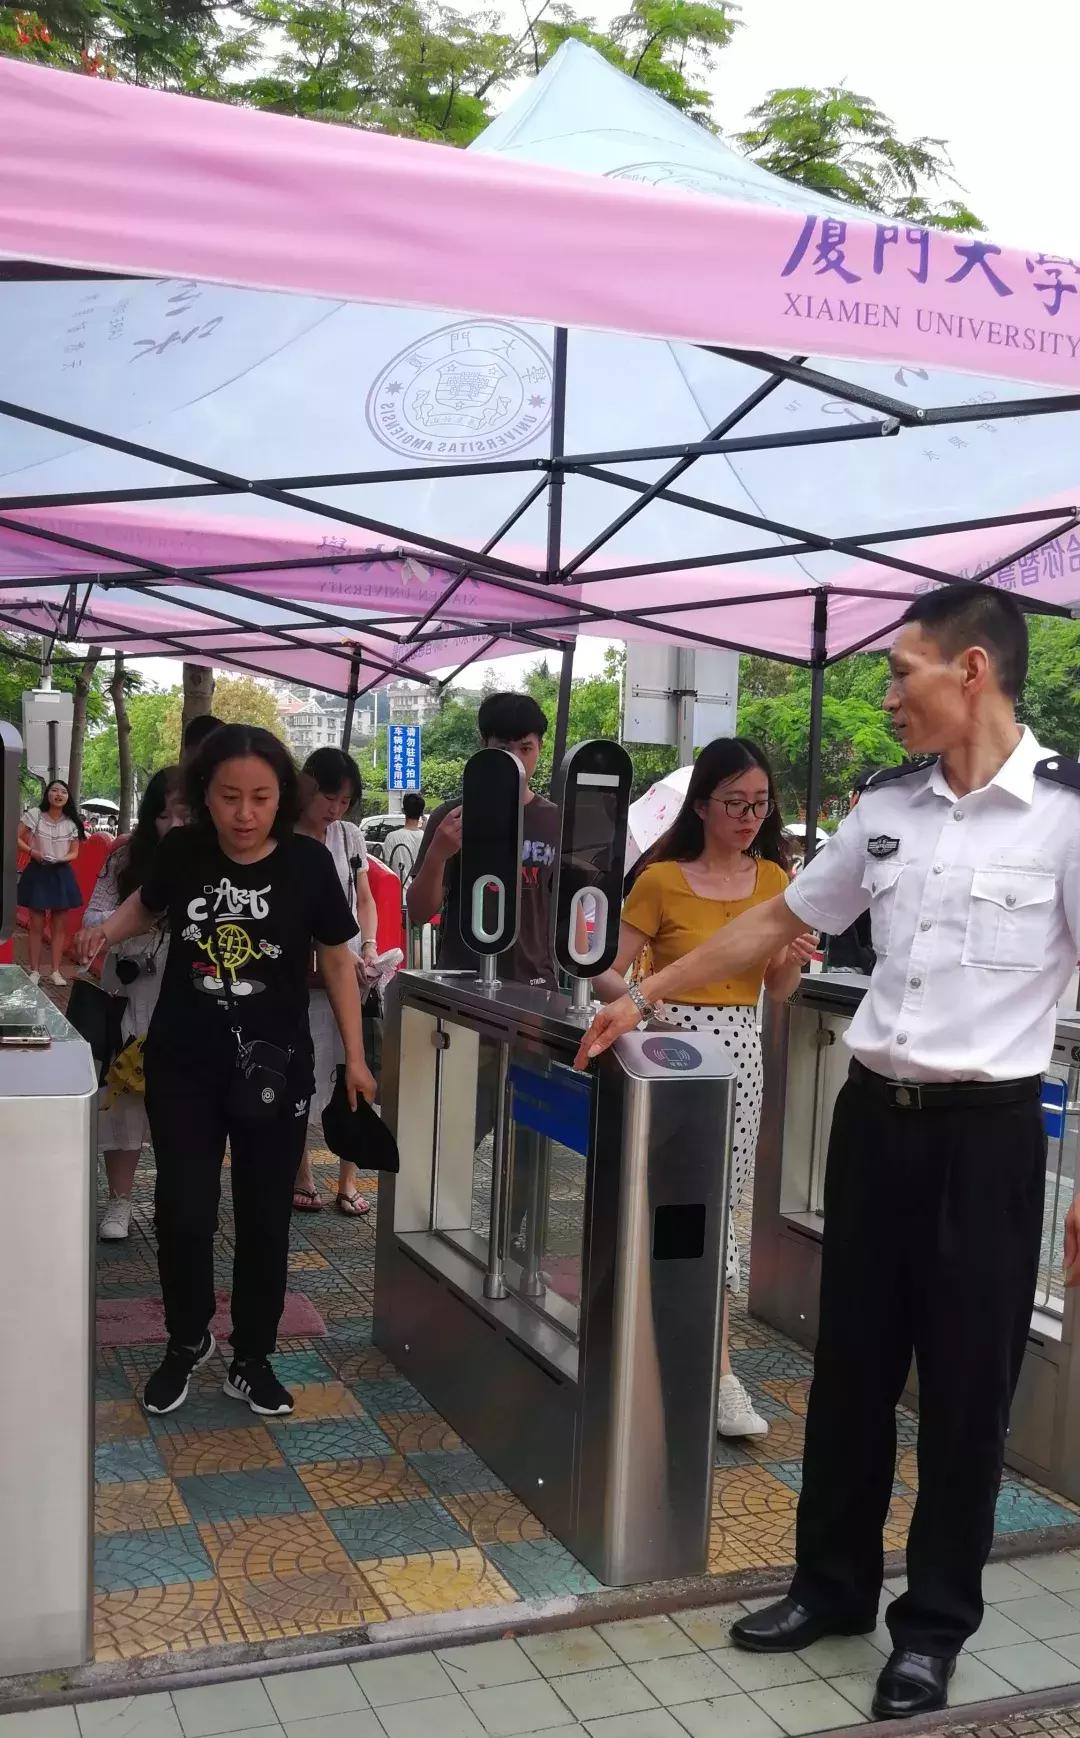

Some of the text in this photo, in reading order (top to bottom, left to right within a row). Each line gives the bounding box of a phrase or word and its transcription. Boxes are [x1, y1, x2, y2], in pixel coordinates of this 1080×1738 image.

[783, 292, 1080, 358] XIAMEN UNIVERSITY
[393, 726, 403, 789] 车辆掉头专用道
[406, 727, 416, 790] 请勿驻足拍照
